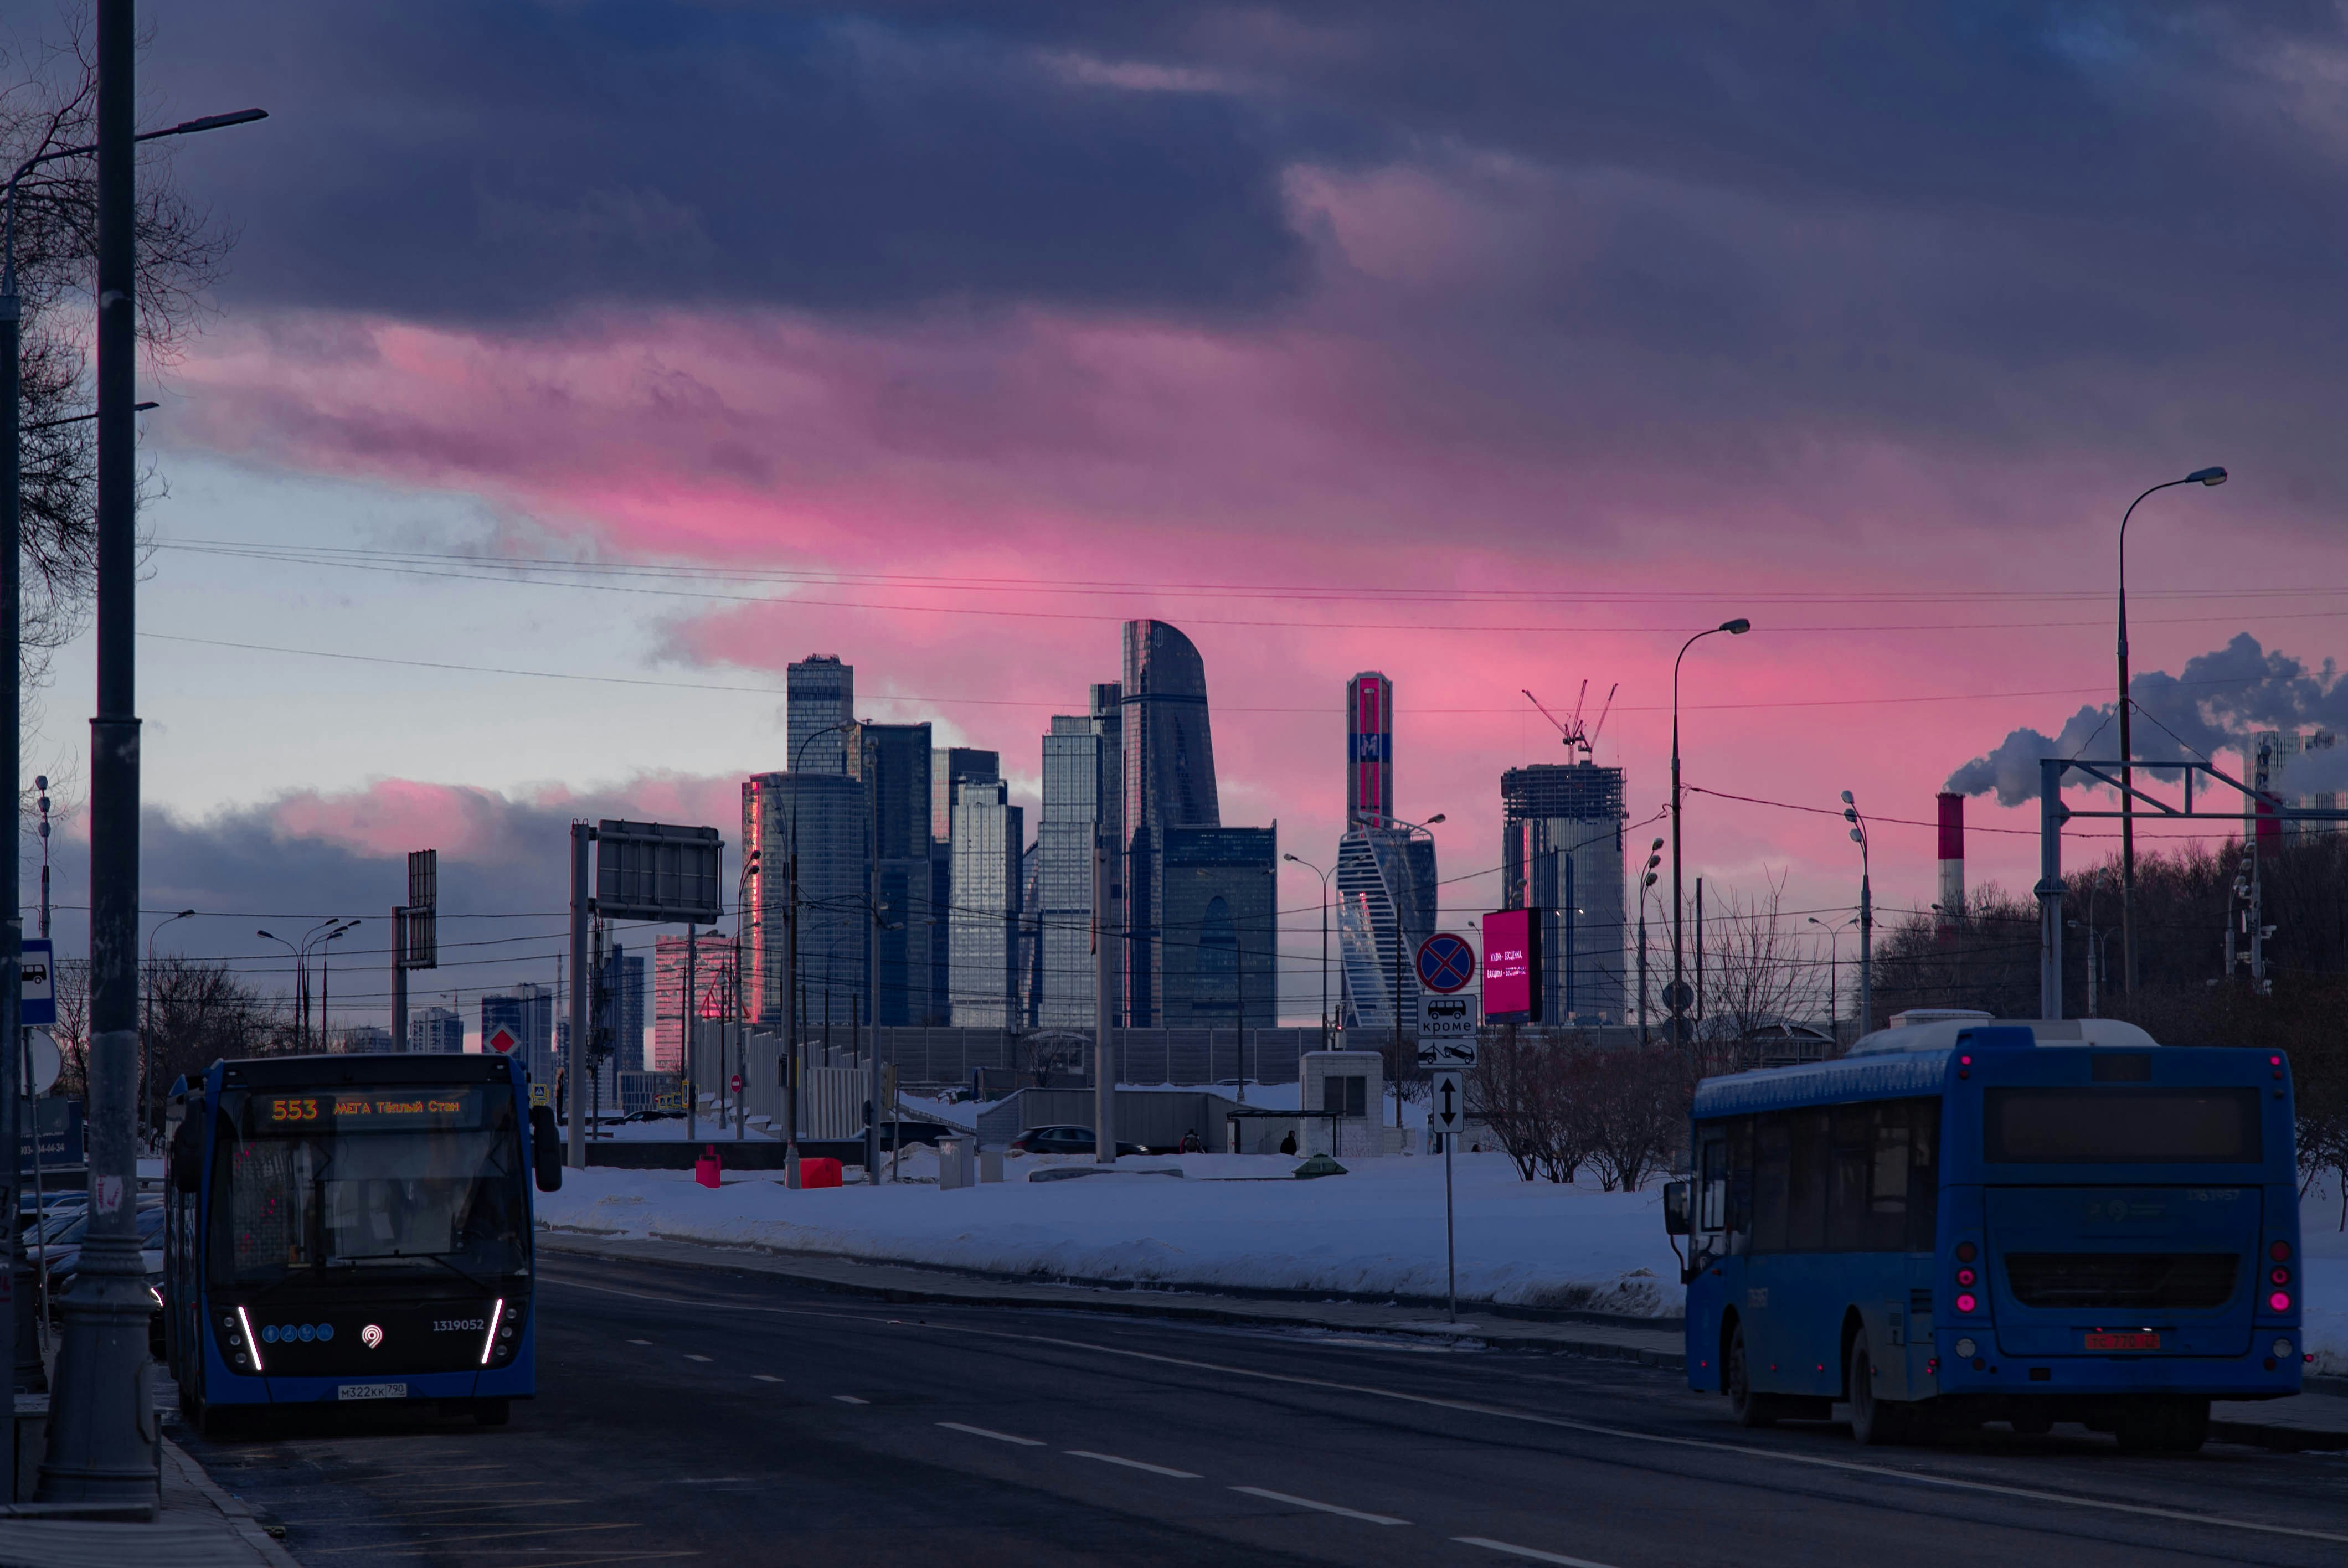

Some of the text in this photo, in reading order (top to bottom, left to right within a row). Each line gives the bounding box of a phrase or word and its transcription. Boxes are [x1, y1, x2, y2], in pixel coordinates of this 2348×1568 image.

[1423, 1022, 1471, 1034] кроме
[272, 1099, 460, 1121] 553 МЕГА Тёплый Стан
[433, 1319, 484, 1332] 1319052
